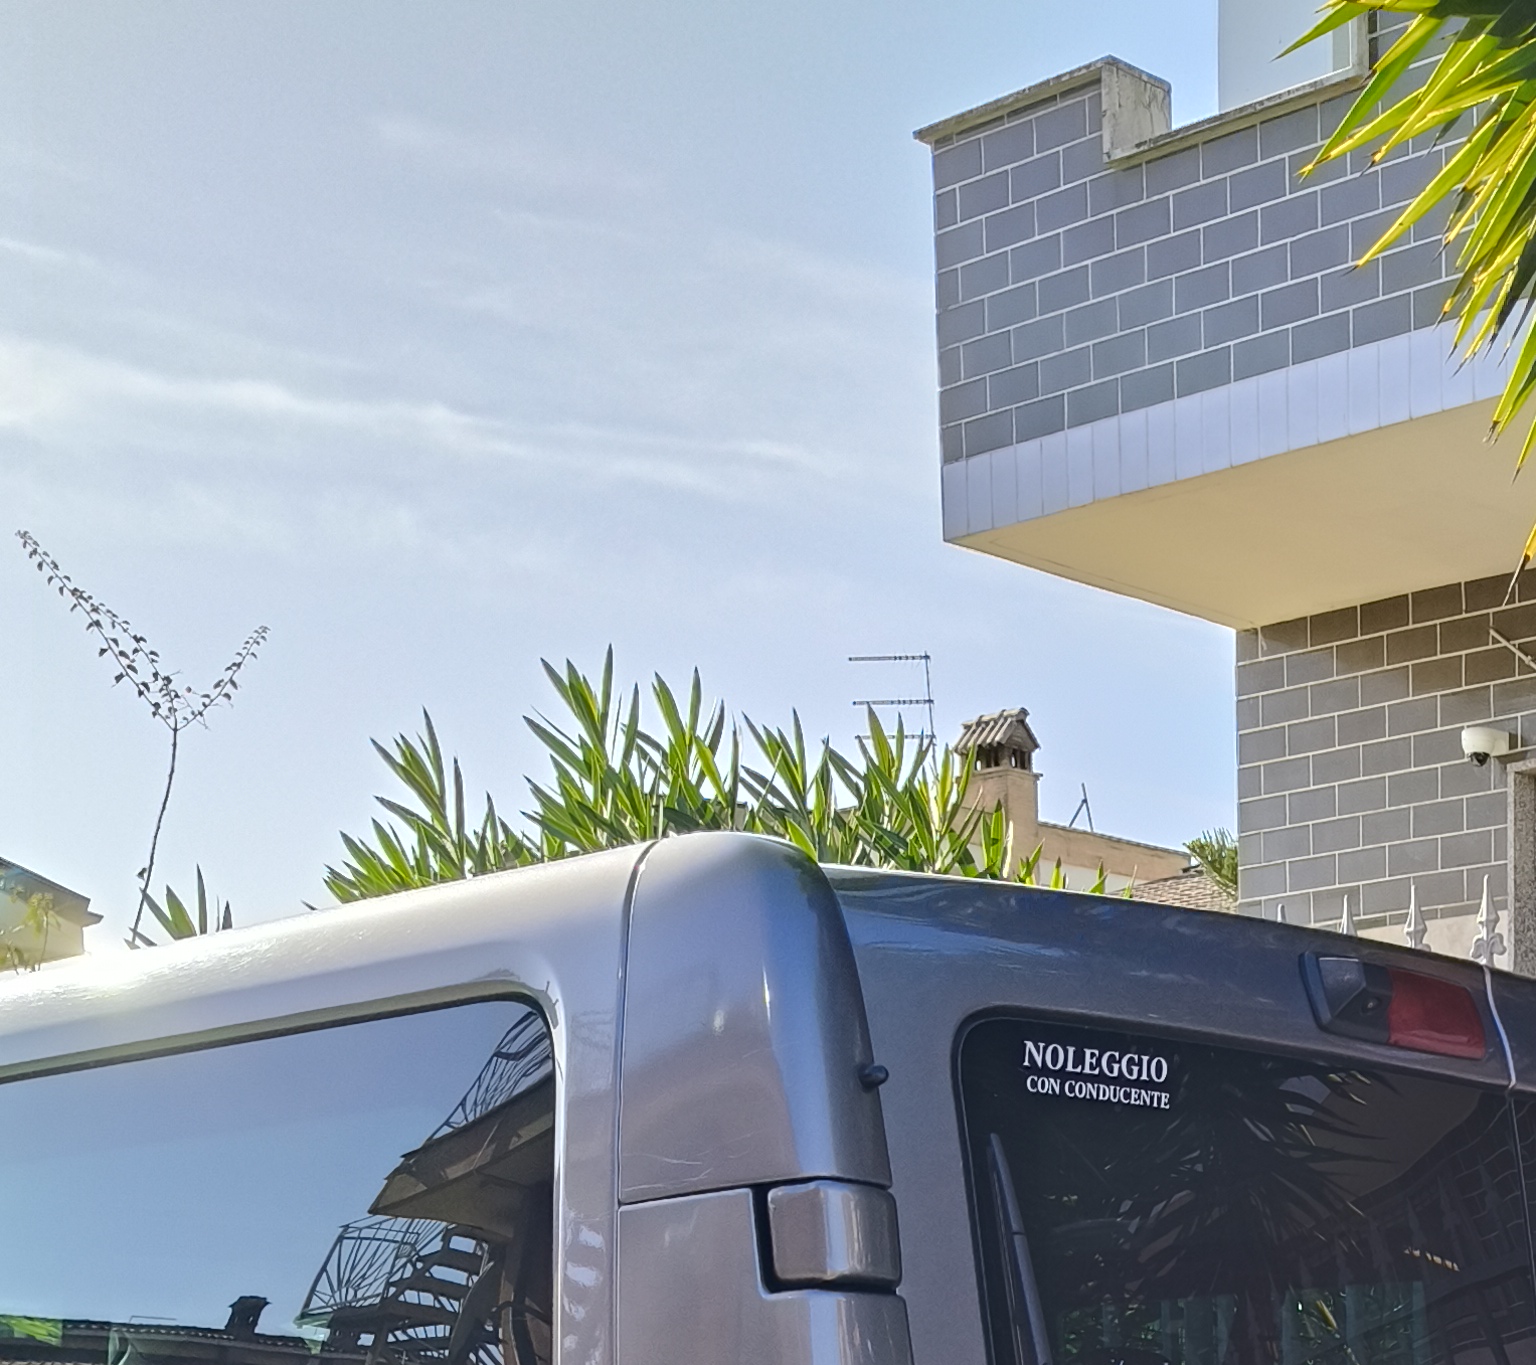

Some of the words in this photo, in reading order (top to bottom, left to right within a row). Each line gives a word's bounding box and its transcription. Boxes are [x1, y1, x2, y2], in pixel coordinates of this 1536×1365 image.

[1022, 1040, 1168, 1084] NOLEGGIO
[1026, 1075, 1061, 1095] CON
[1064, 1080, 1170, 1110] CONDUCENTE
